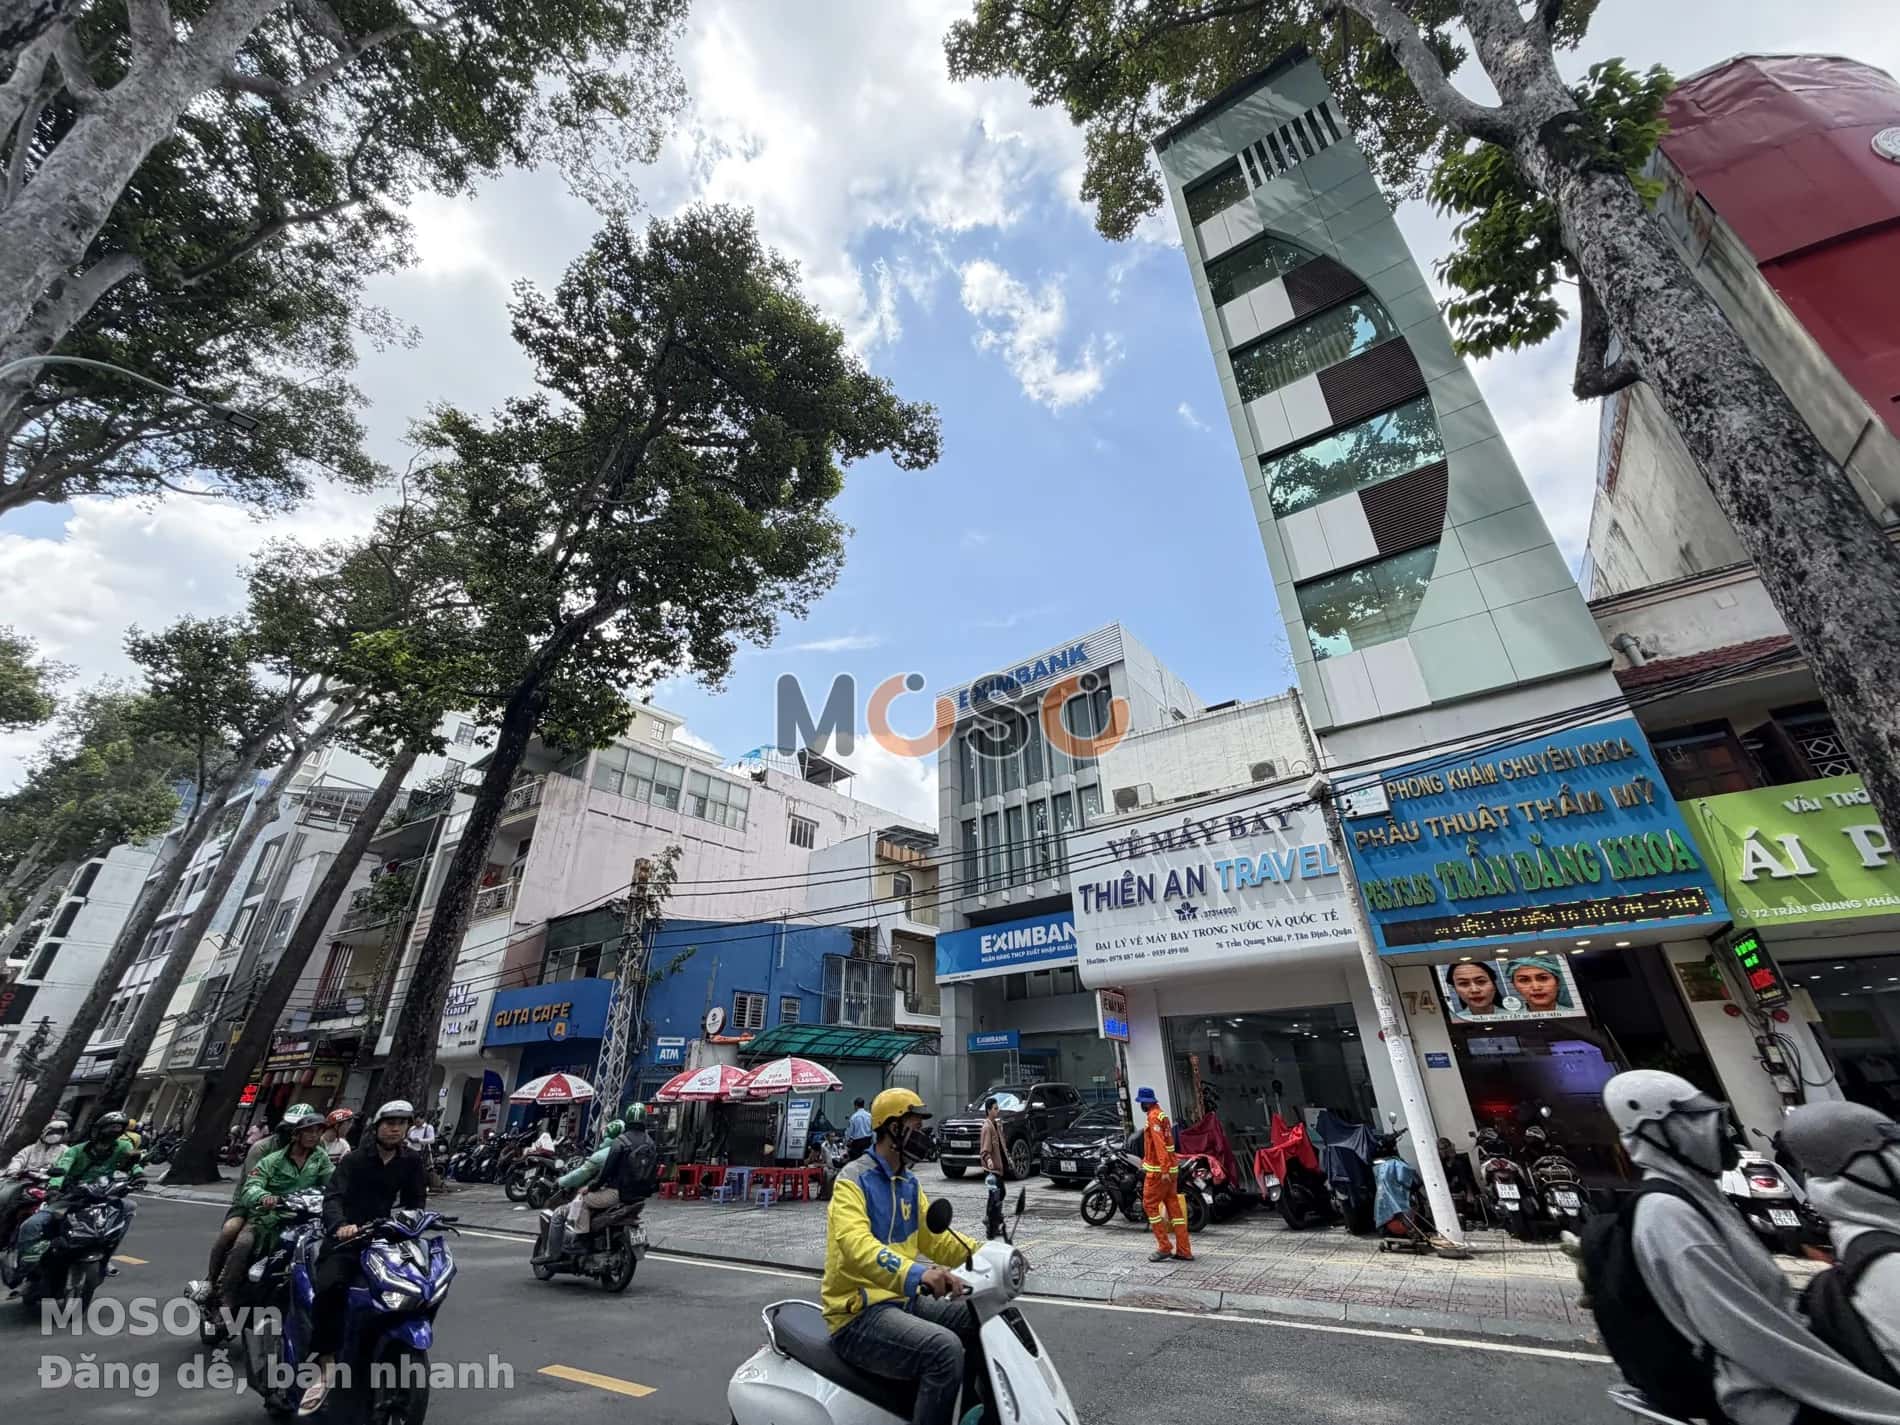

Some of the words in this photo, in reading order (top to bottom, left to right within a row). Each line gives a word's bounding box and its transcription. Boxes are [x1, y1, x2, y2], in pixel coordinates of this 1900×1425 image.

[958, 642, 1088, 709] EXIMBANK
[1446, 761, 1498, 791] KHÁM
[1499, 745, 1577, 781] CHUYÊN
[1577, 736, 1638, 766] KHOA
[1226, 808, 1293, 841] BAY
[1354, 815, 1420, 849] PHẪU
[1424, 804, 1509, 838] THUẬT
[1516, 783, 1604, 822] THẨM
[1609, 775, 1655, 808] MỸ
[1434, 835, 1517, 899] TRẦN
[1511, 832, 1601, 890] ĐĂNG
[1598, 829, 1700, 881] KHOA
[1739, 825, 1819, 881] ÁI
[1079, 870, 1156, 914] THIÊN
[1163, 864, 1207, 900] AN
[1215, 843, 1339, 893] TRAVEL
[1811, 900, 1863, 913] QUANG
[1115, 937, 1128, 949] LÝ
[1129, 936, 1144, 946] VÉ
[1146, 932, 1168, 945] MÁY
[1170, 931, 1190, 942] BAY
[1192, 925, 1228, 938] TRONG
[1231, 919, 1264, 933] NƯỚC
[1266, 916, 1282, 929] VÀ
[1285, 911, 1318, 927] QUỐC
[1319, 908, 1340, 922] TẾ
[1243, 937, 1266, 947] Quang
[1332, 928, 1352, 937] Quận
[495, 1008, 529, 1027] GUTA
[532, 1002, 572, 1022] CAFE
[1401, 990, 1436, 1015] 74
[658, 1048, 679, 1060] ATM
